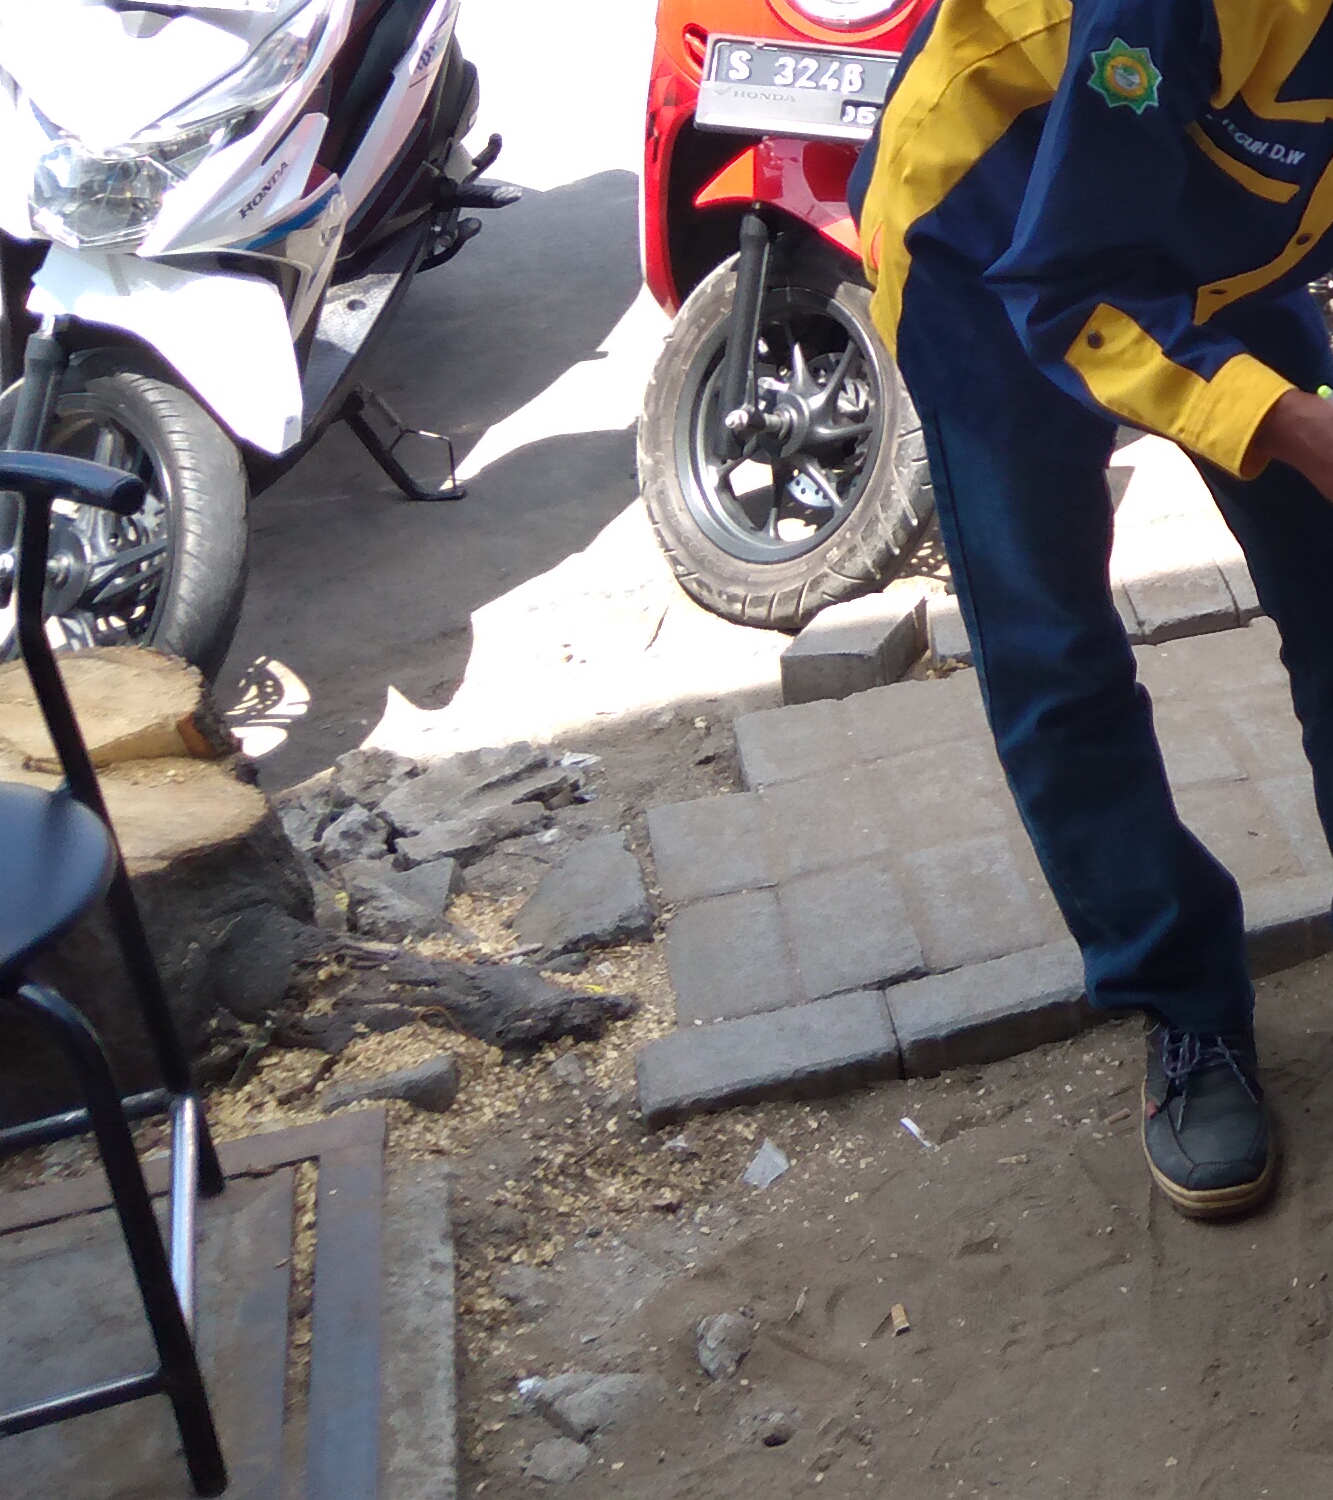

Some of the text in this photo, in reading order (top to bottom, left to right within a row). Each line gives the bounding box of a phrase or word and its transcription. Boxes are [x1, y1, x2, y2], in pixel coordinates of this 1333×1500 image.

[728, 50, 753, 81] S
[732, 90, 797, 103] HONDA
[238, 161, 289, 220] HONDA
